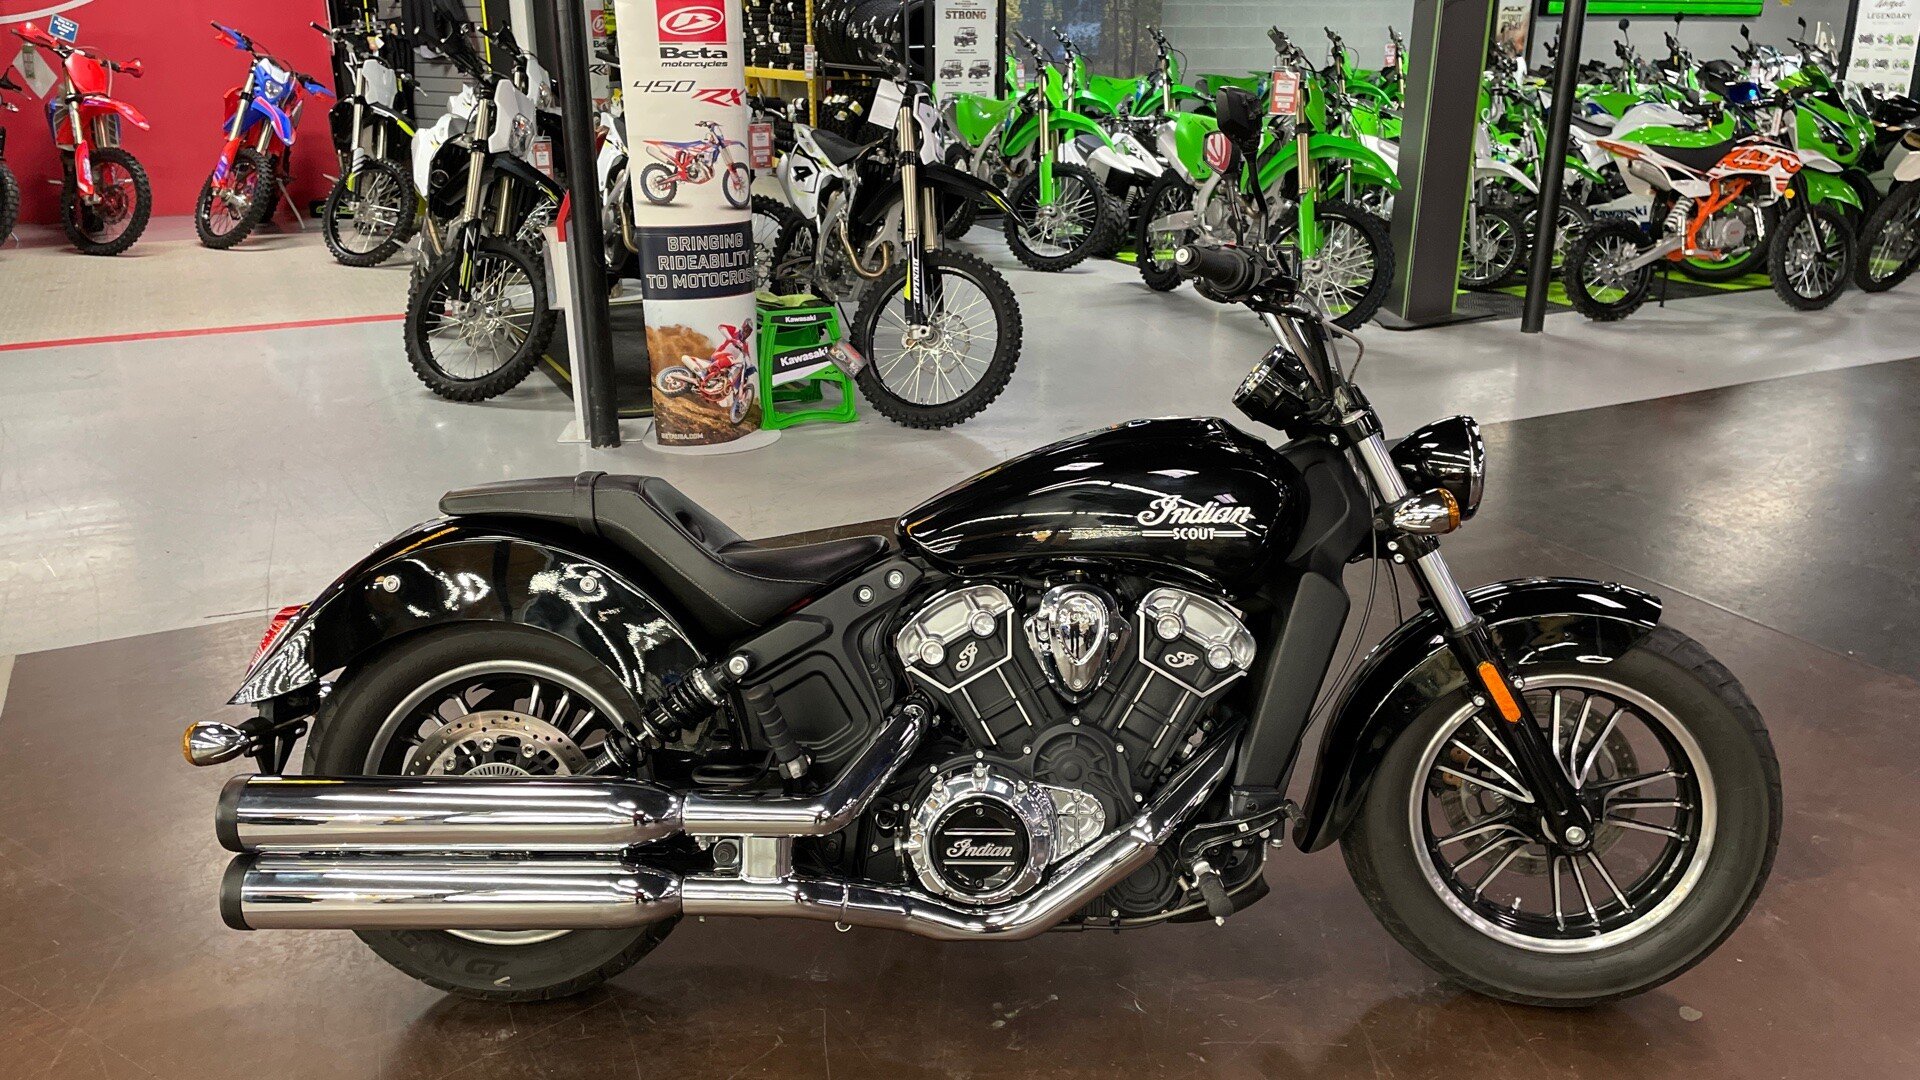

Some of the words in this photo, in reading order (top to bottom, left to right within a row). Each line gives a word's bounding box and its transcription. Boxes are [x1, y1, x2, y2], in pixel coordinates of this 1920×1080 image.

[945, 10, 987, 19] STRONG
[659, 47, 728, 59] Beta
[661, 60, 728, 69] motorcycles
[633, 80, 696, 93] 450
[667, 232, 744, 252] BRINGING
[657, 249, 751, 271] RIDEABILITY
[646, 274, 668, 290] TO
[672, 267, 755, 290] MOTOCROS
[785, 315, 817, 323] Kawasaki
[780, 346, 828, 367] Kawasaki
[1137, 495, 1251, 526] Indian
[1173, 527, 1216, 540] SCOUT
[946, 838, 1013, 858] Indian
